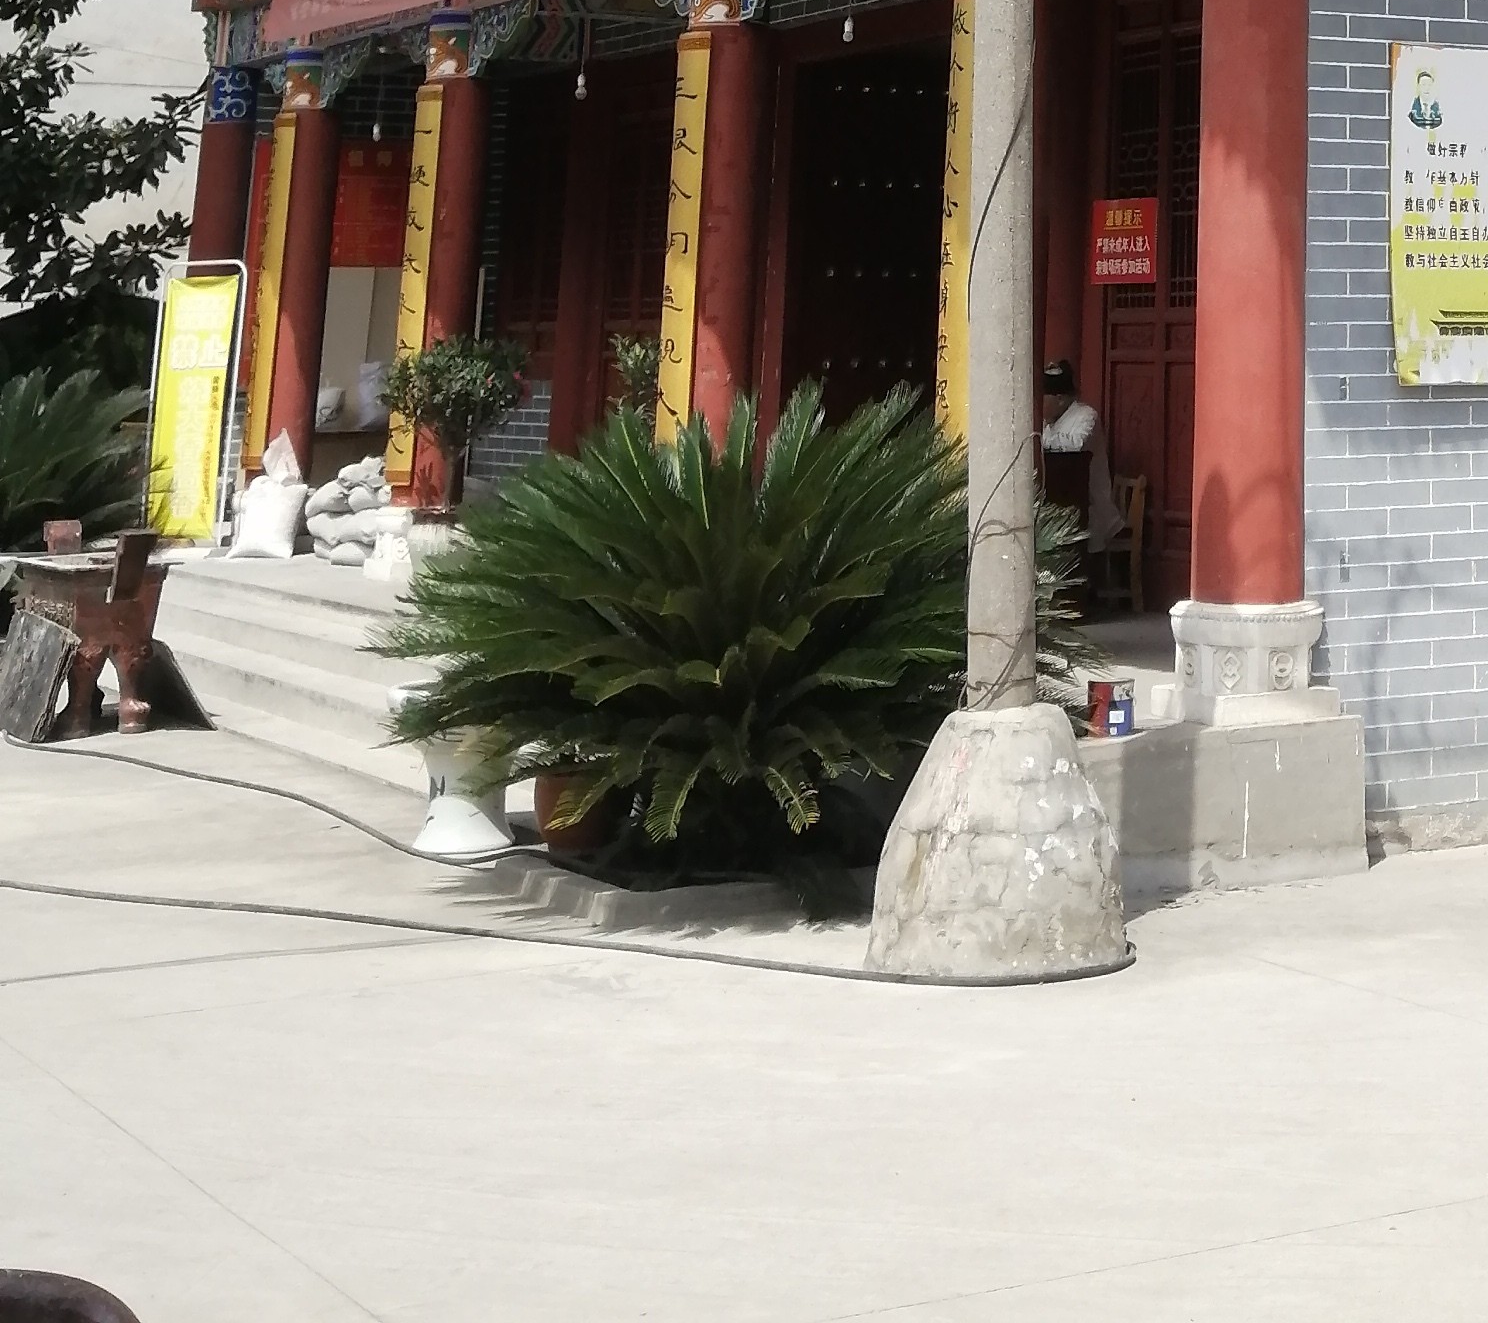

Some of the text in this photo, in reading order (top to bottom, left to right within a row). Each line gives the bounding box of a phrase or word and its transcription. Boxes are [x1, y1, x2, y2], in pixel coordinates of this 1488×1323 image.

[1105, 209, 1143, 227] 温馨提示
[1095, 235, 1151, 254] 严禁未成年人进入
[1095, 257, 1151, 275] 宗教场所参加活动
